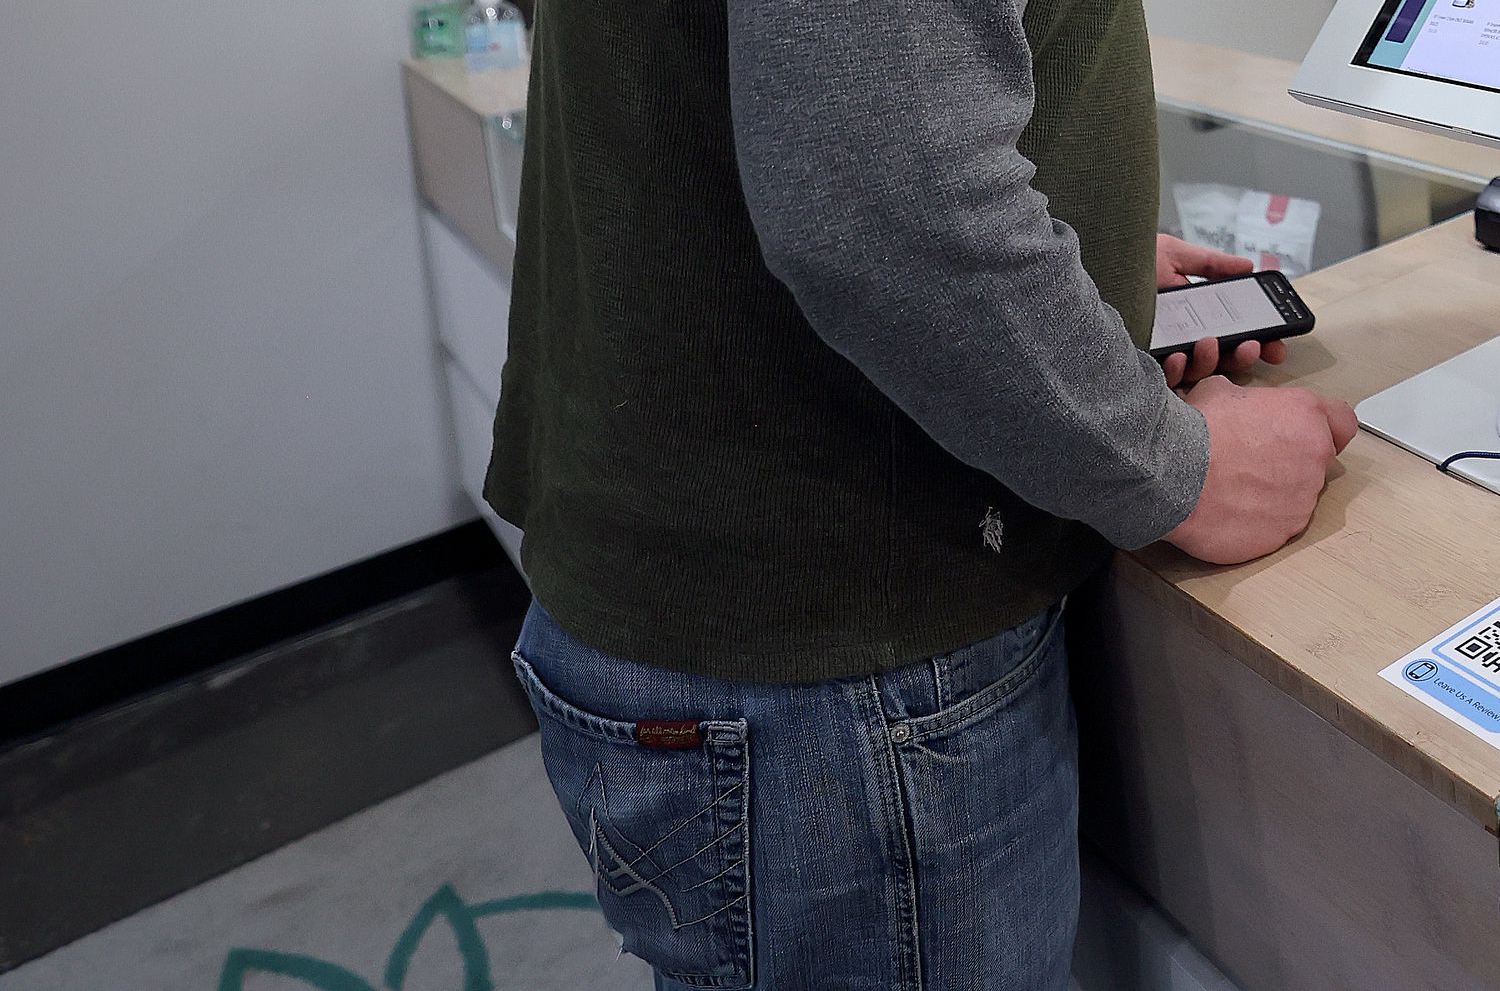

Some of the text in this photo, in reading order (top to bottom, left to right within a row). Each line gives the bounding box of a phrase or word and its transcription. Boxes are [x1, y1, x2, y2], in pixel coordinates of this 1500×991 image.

[1433, 678, 1456, 694] Leave
[1455, 691, 1466, 701] Us
[1465, 697, 1472, 705] A
